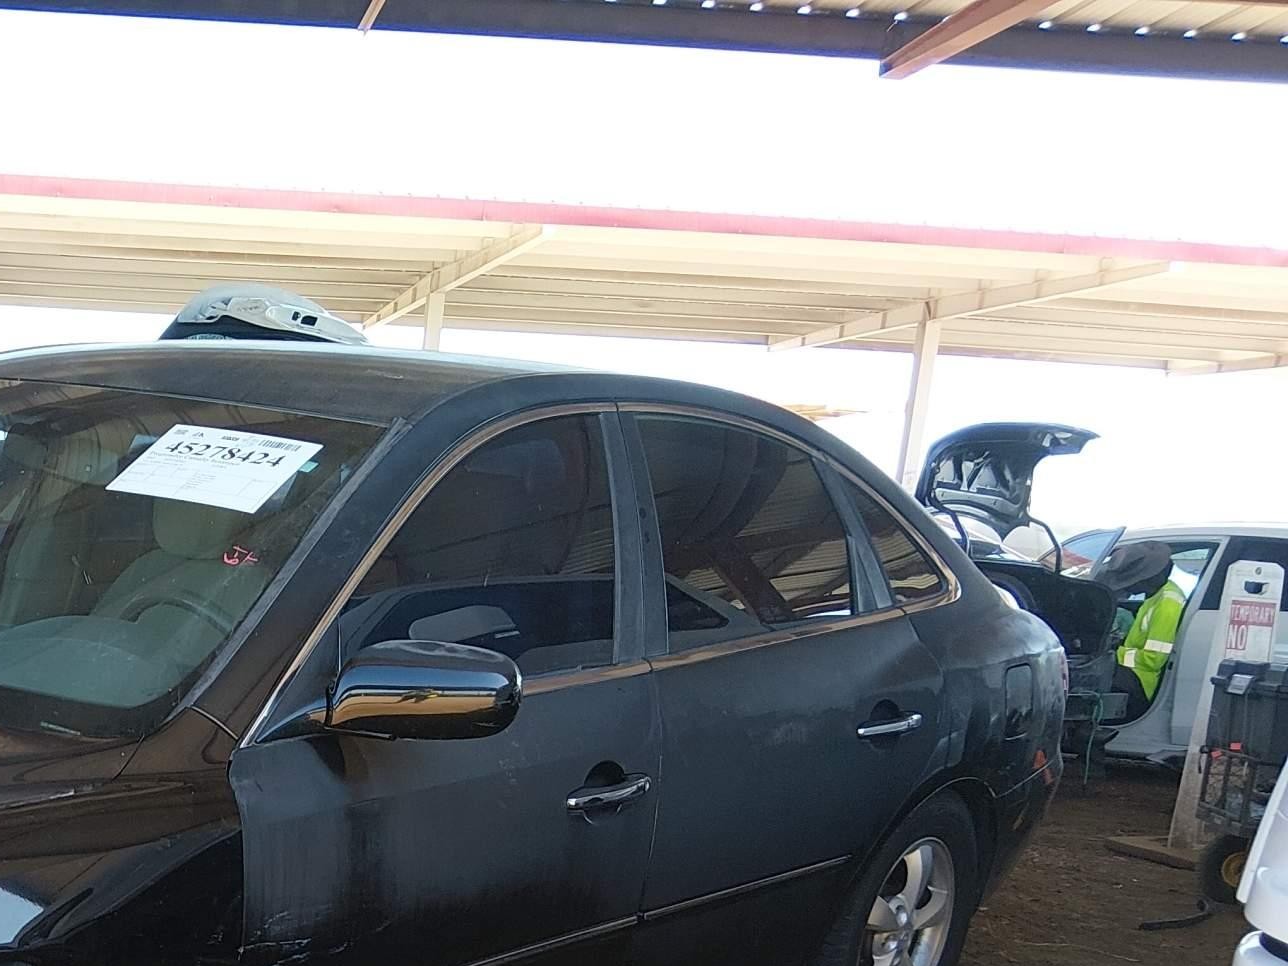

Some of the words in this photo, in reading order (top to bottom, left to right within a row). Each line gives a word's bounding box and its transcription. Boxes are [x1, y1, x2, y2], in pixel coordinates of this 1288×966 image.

[165, 440, 286, 467] 45278424
[1230, 604, 1275, 624] TEMPORARY
[1227, 624, 1249, 650] NO
